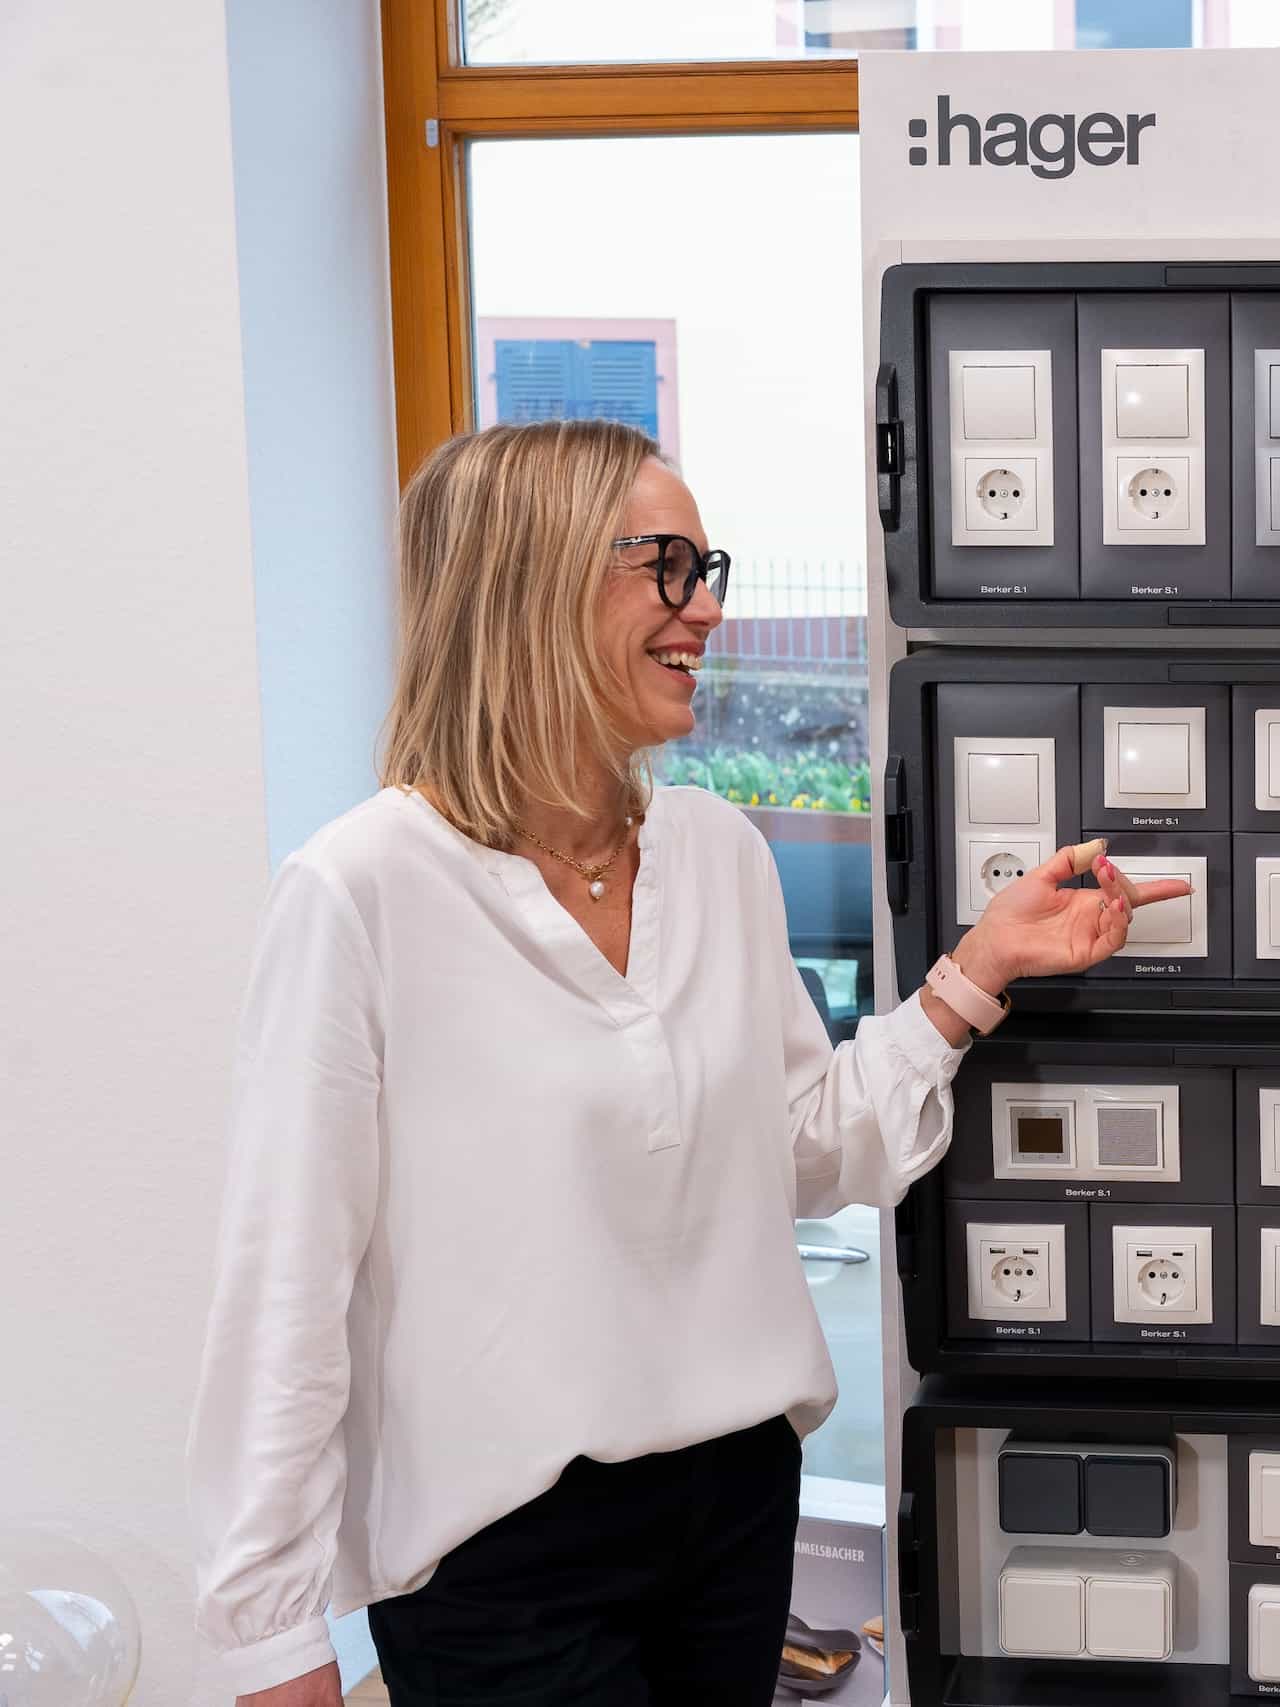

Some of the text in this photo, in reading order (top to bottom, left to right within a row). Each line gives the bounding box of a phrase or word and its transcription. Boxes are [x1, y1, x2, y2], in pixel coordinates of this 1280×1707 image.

[1165, 586, 1178, 594] S.1
[1133, 817, 1179, 825] Berker S.1
